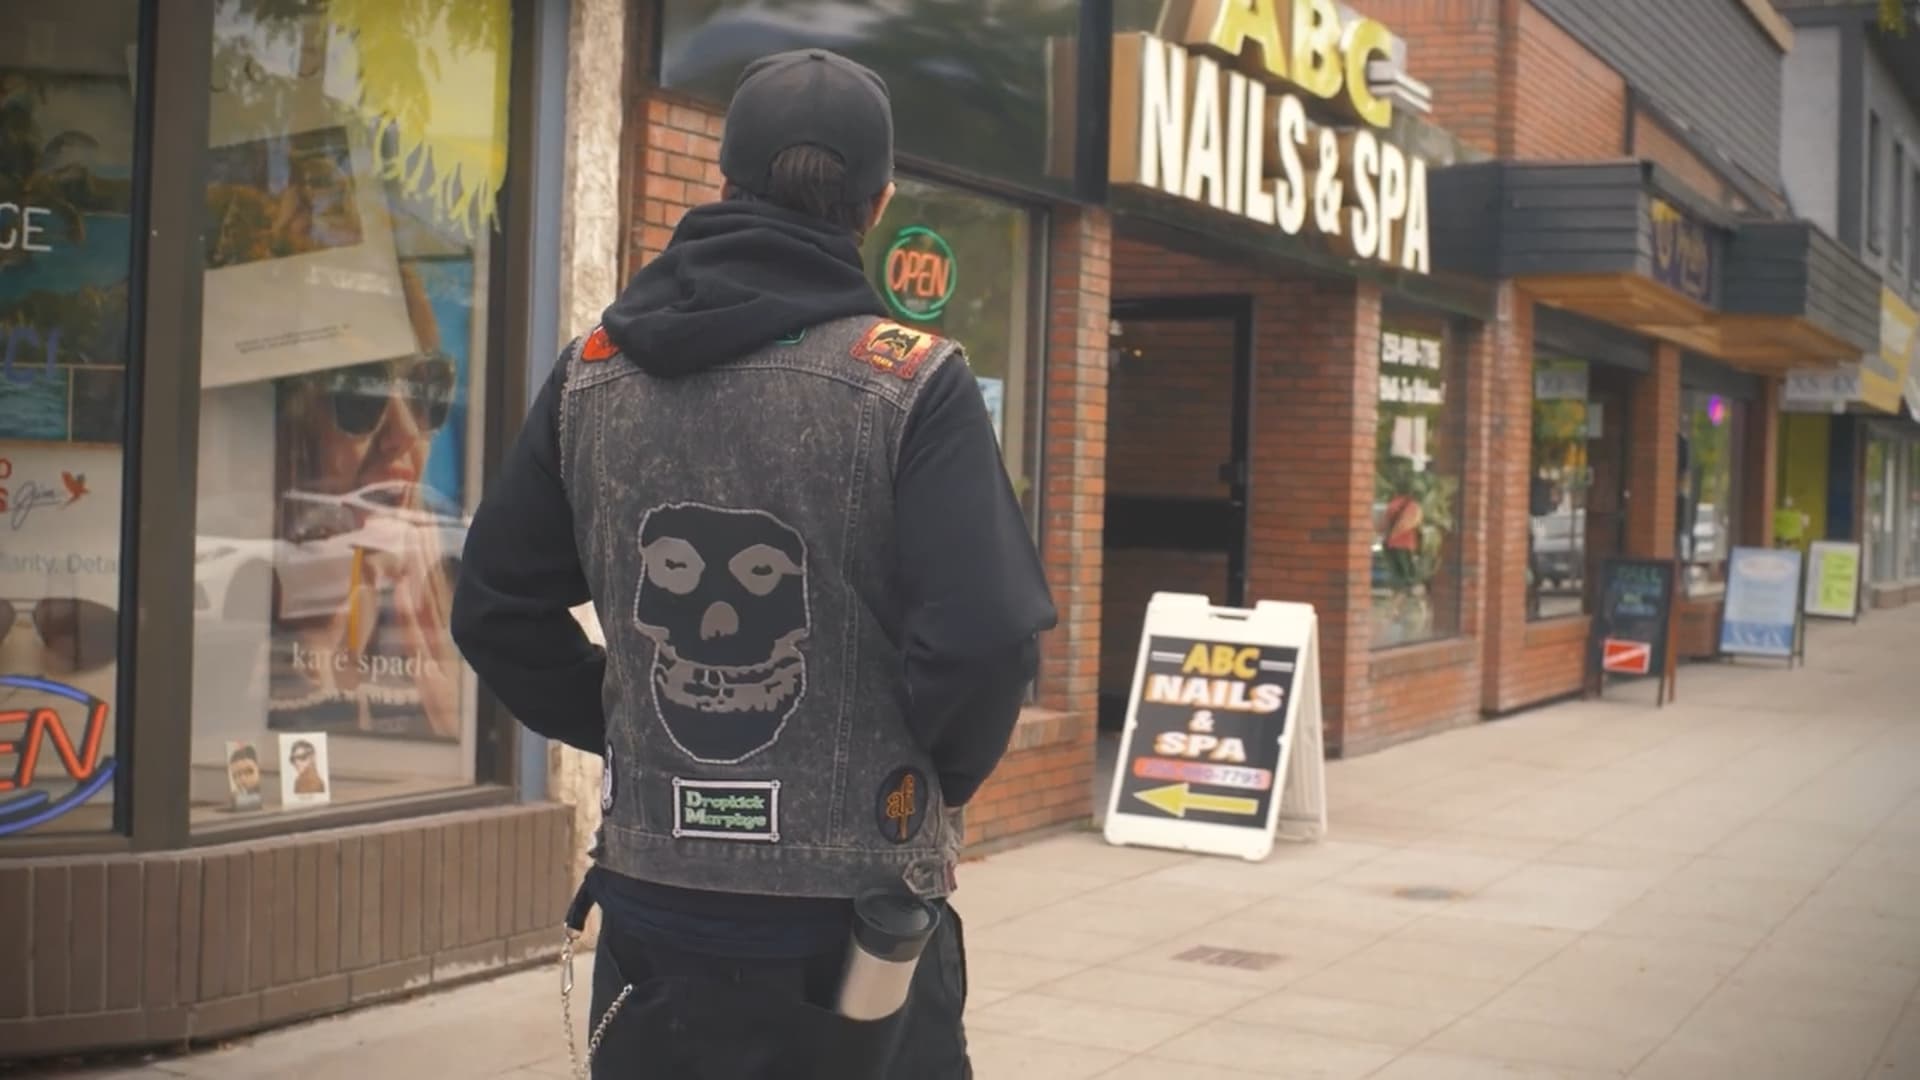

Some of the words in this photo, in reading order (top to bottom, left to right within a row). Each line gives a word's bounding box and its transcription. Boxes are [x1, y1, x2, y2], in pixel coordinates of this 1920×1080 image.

[1208, 0, 1392, 128] ABC
[1141, 33, 1307, 235] NAILS
[1314, 127, 1343, 236] &
[1351, 130, 1430, 275] SPA
[887, 248, 950, 298] OPEN
[1181, 642, 1261, 680] ABC
[1144, 673, 1285, 715] NAILS
[1188, 709, 1215, 733] &
[1153, 731, 1247, 763] SPA
[684, 790, 765, 811] Dropkick
